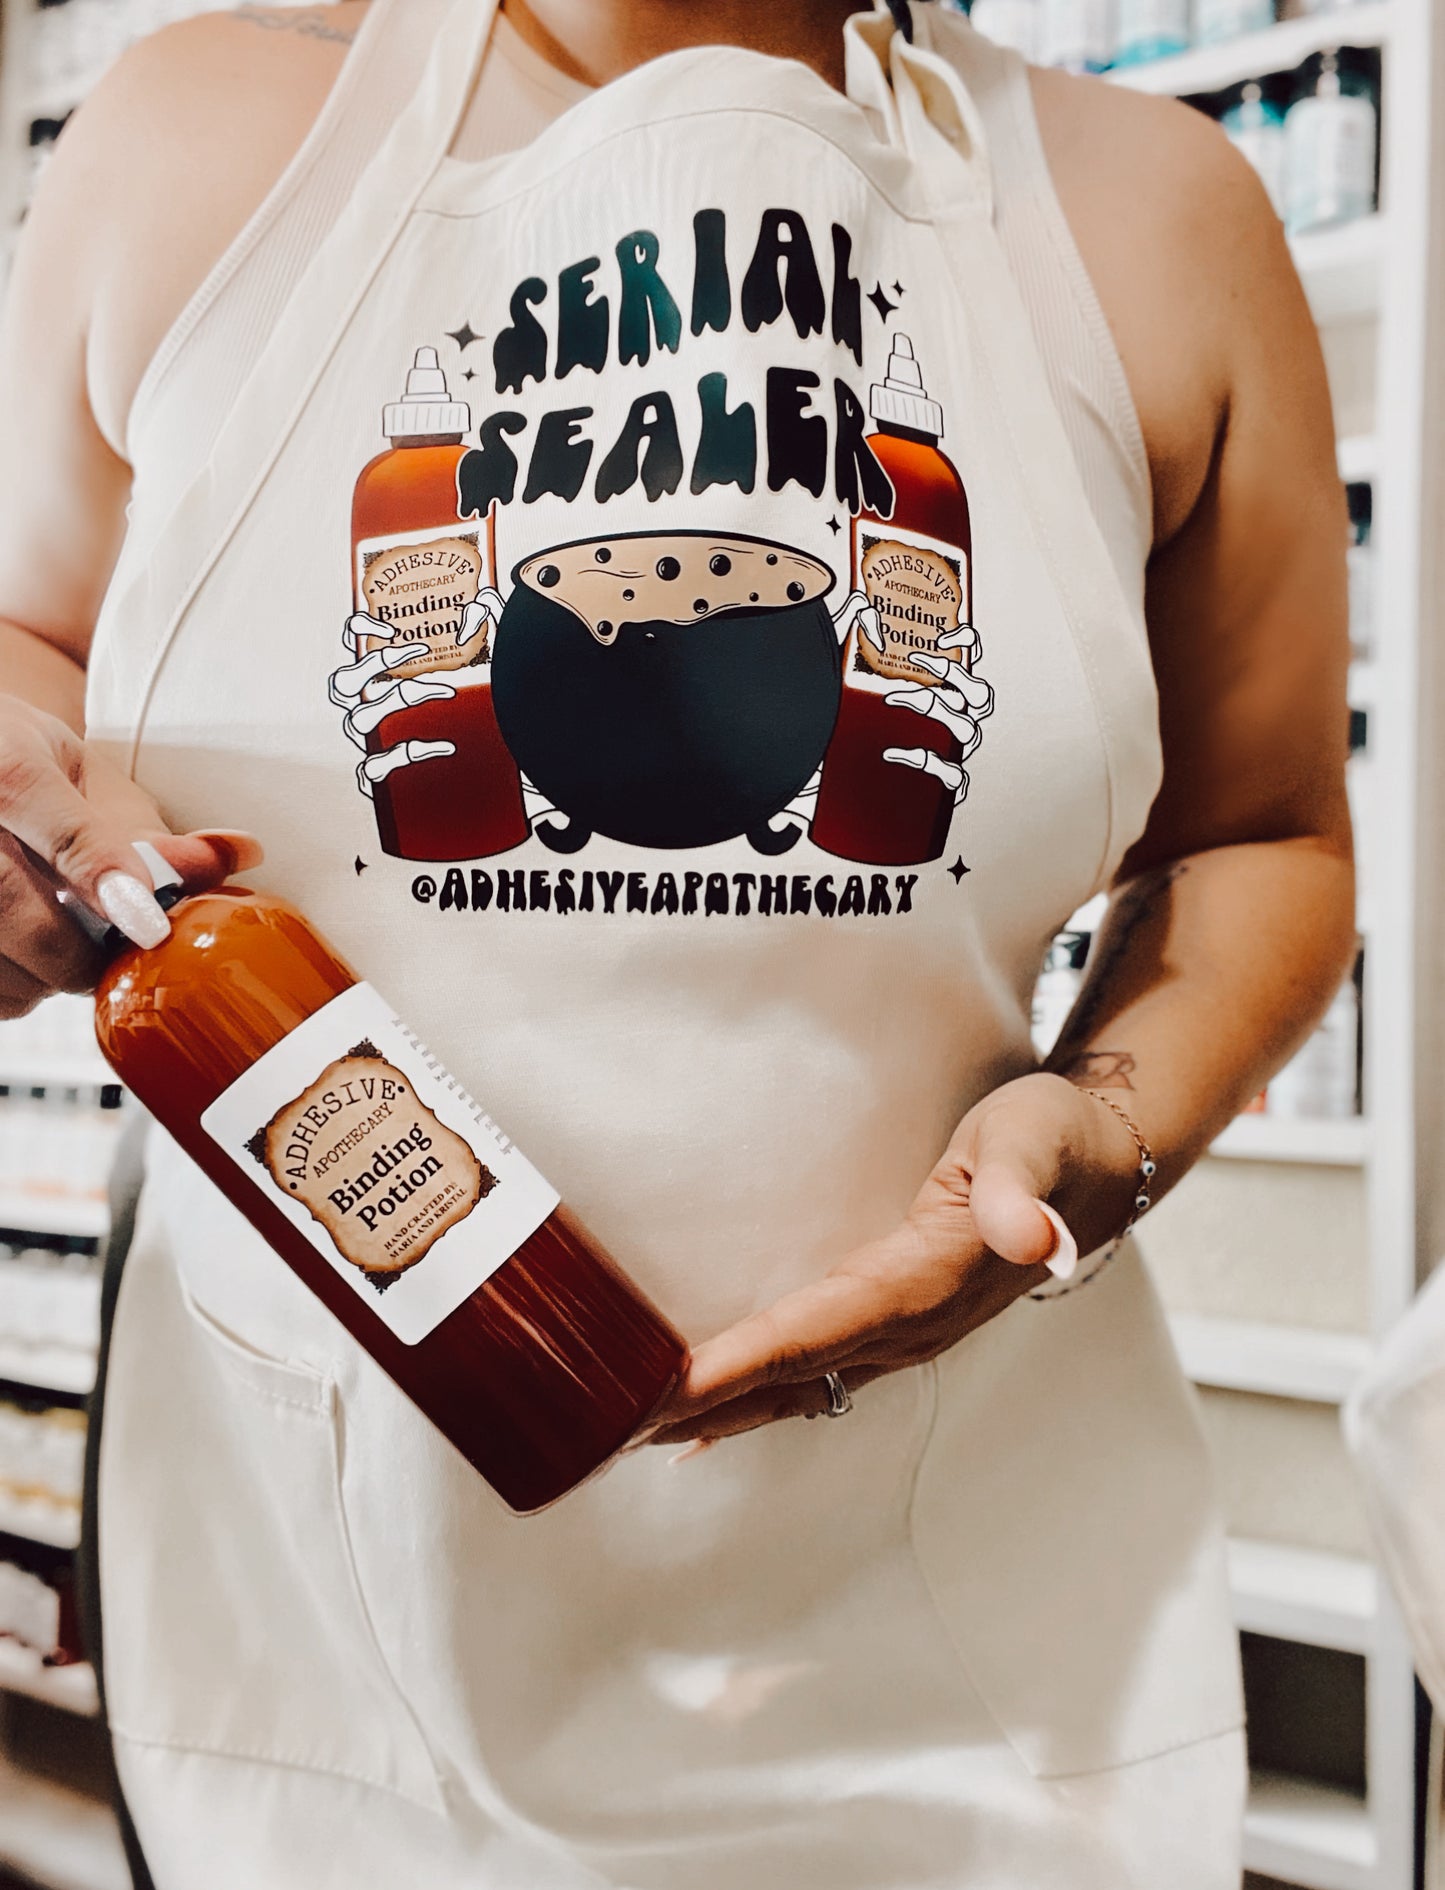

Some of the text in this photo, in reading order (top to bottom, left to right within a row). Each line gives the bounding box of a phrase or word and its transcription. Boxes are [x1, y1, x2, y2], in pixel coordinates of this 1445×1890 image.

[493, 208, 863, 395] SERIAL
[458, 367, 895, 519] SEALER
[374, 552, 471, 592] ADHESIVE
[389, 573, 457, 595] APOTHECARY
[872, 555, 954, 599] ADHESIVE
[885, 579, 942, 604] APOTHECARY
[377, 591, 465, 622] Binding
[874, 595, 947, 634] Binding
[411, 868, 919, 917] @ADHESIVEAPOTHECARY
[285, 1077, 396, 1180] ADHESIVE
[312, 1102, 393, 1178] APOTHECARY
[328, 1122, 432, 1215] Binding
[356, 1156, 444, 1232] Potion
[407, 1193, 445, 1228] CRAFTED
[389, 1189, 468, 1258] MARIA AND KRISTAL
